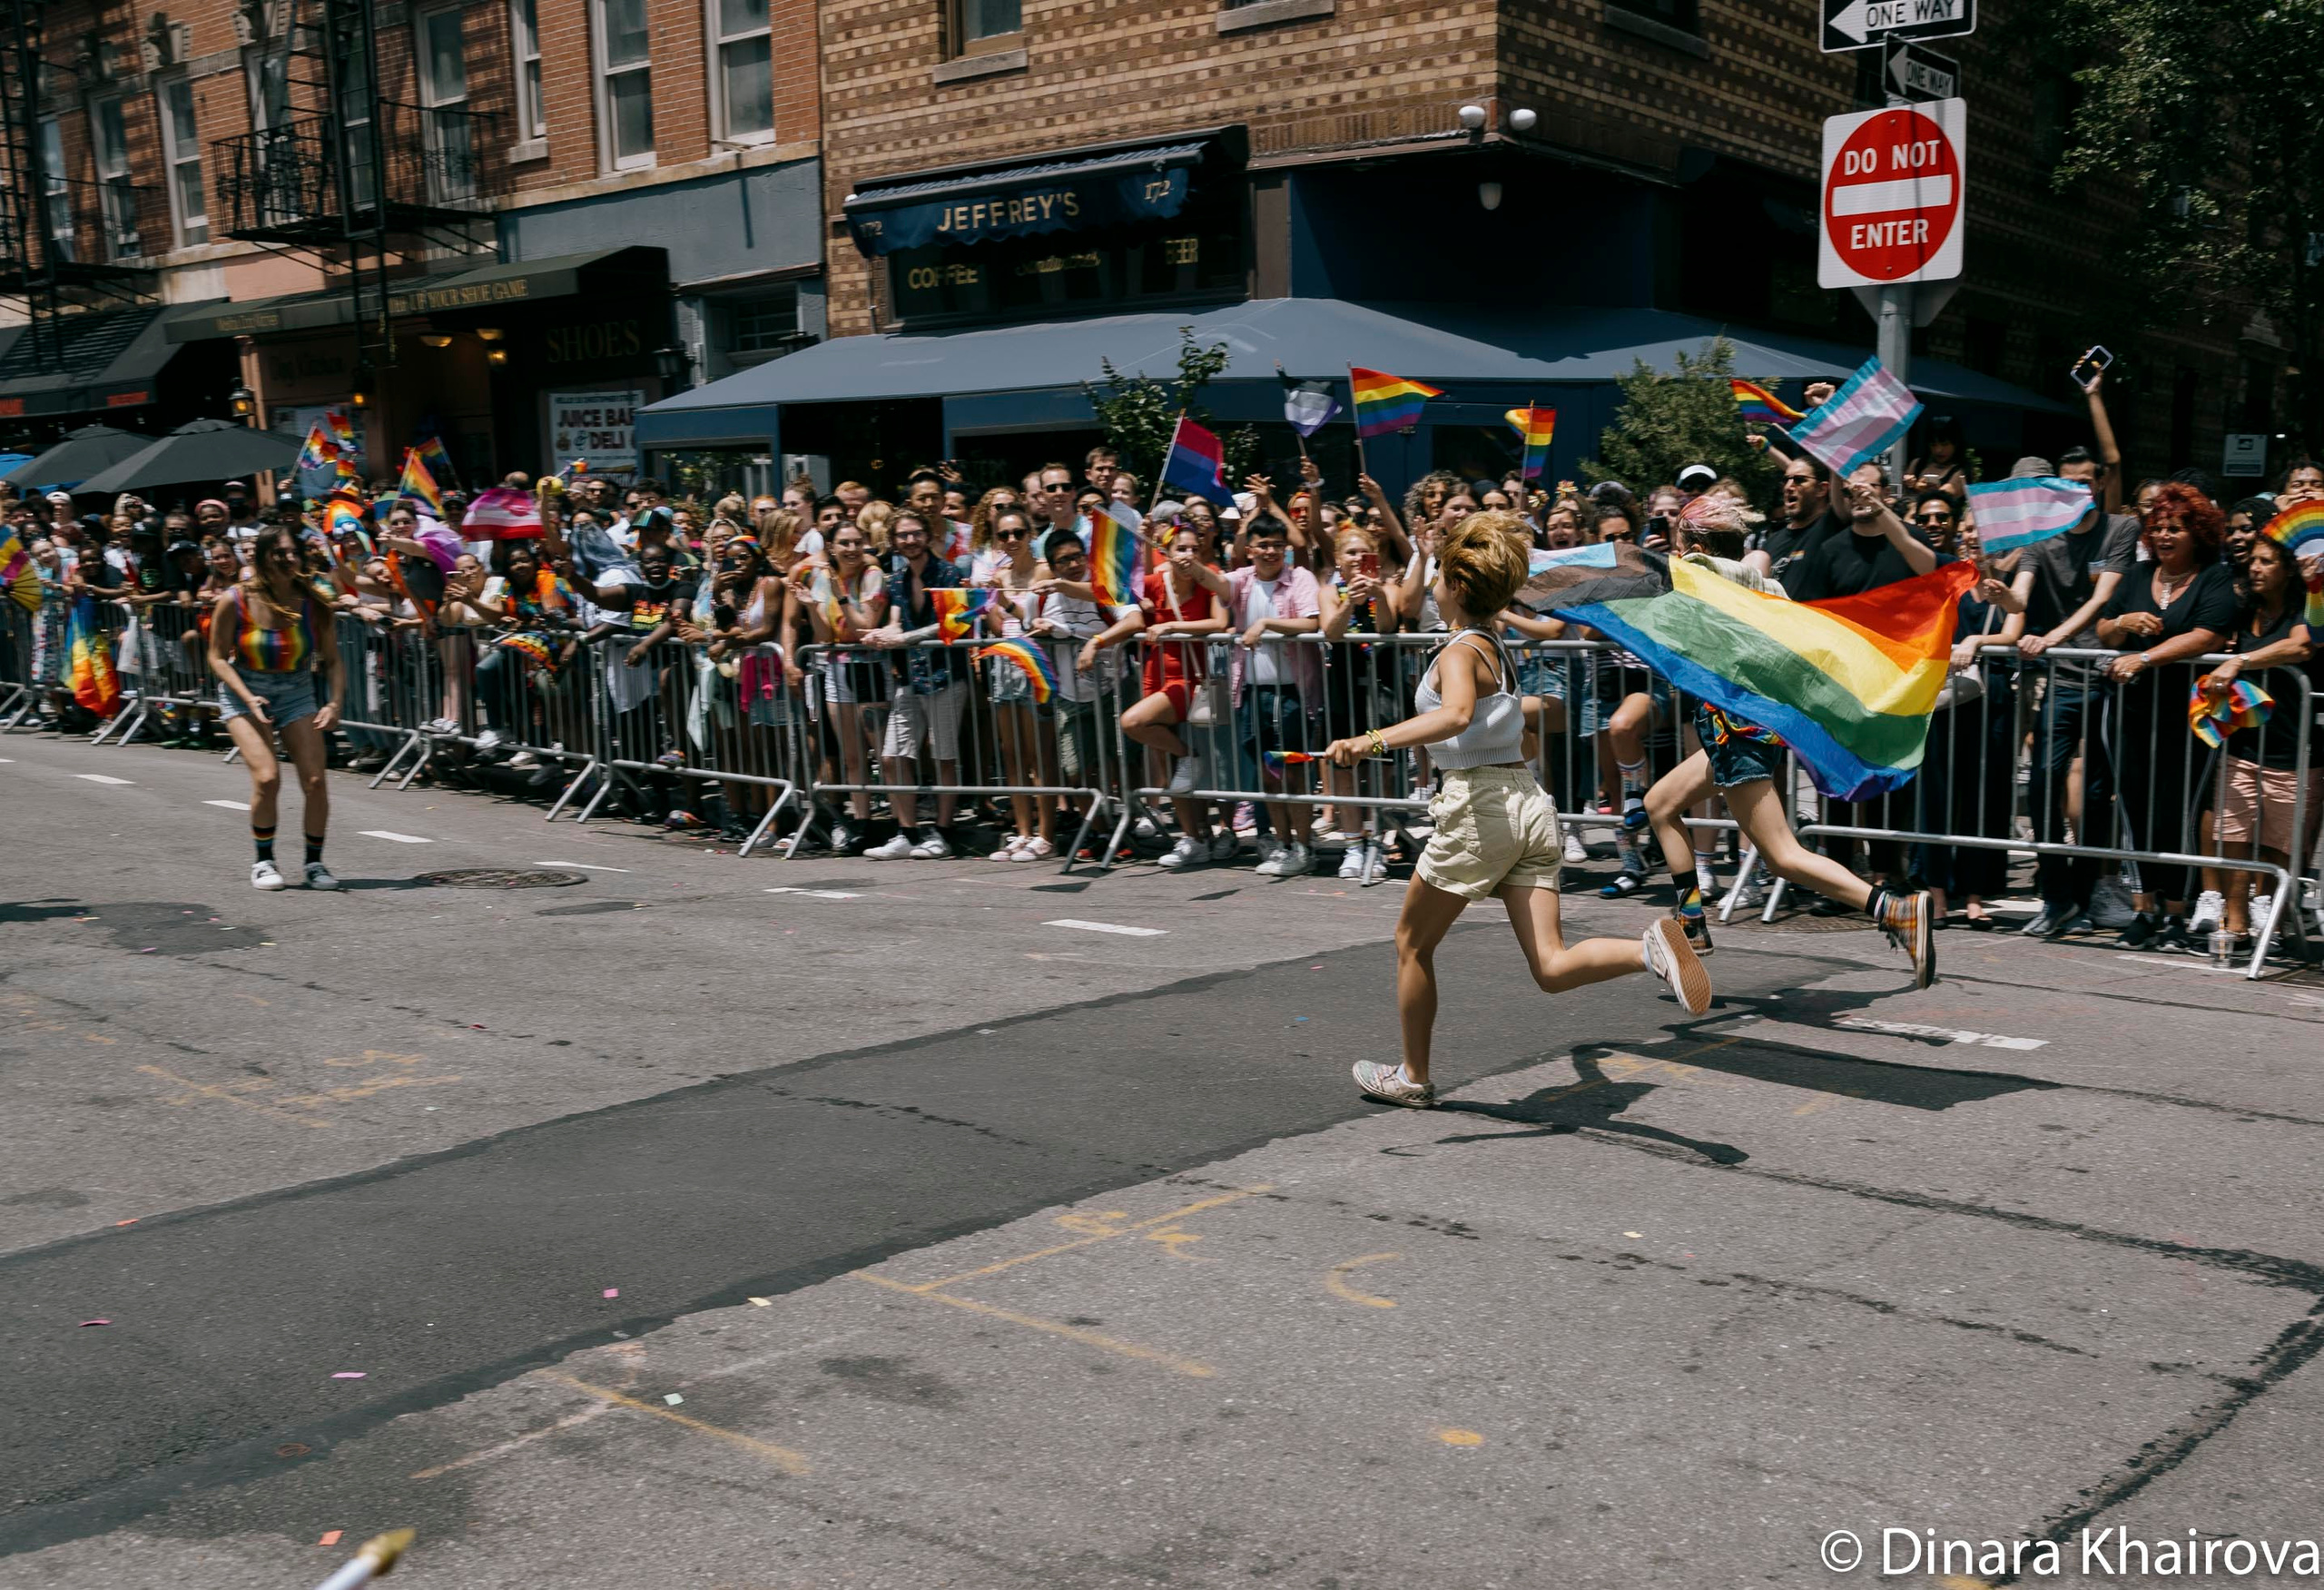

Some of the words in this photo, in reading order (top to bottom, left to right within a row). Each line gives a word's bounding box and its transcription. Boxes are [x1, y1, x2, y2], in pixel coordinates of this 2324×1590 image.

[1867, 3, 1905, 27] ONE
[1915, 0, 1954, 21] WAY
[1906, 61, 1926, 88] ONE
[1929, 70, 1951, 96] WAY
[1844, 148, 1877, 175] DO
[1892, 140, 1941, 170] NOT
[937, 192, 1080, 232] JEFFREY'S
[1144, 180, 1170, 203] 172
[1851, 219, 1929, 250] ENTER
[908, 263, 980, 290] COFFEE
[1165, 238, 1198, 265] BEER
[460, 284, 491, 304] SHOE
[492, 280, 528, 300] GAME
[546, 320, 640, 363] SHOES
[557, 409, 602, 428] JUICE
[588, 430, 625, 449] DELI
